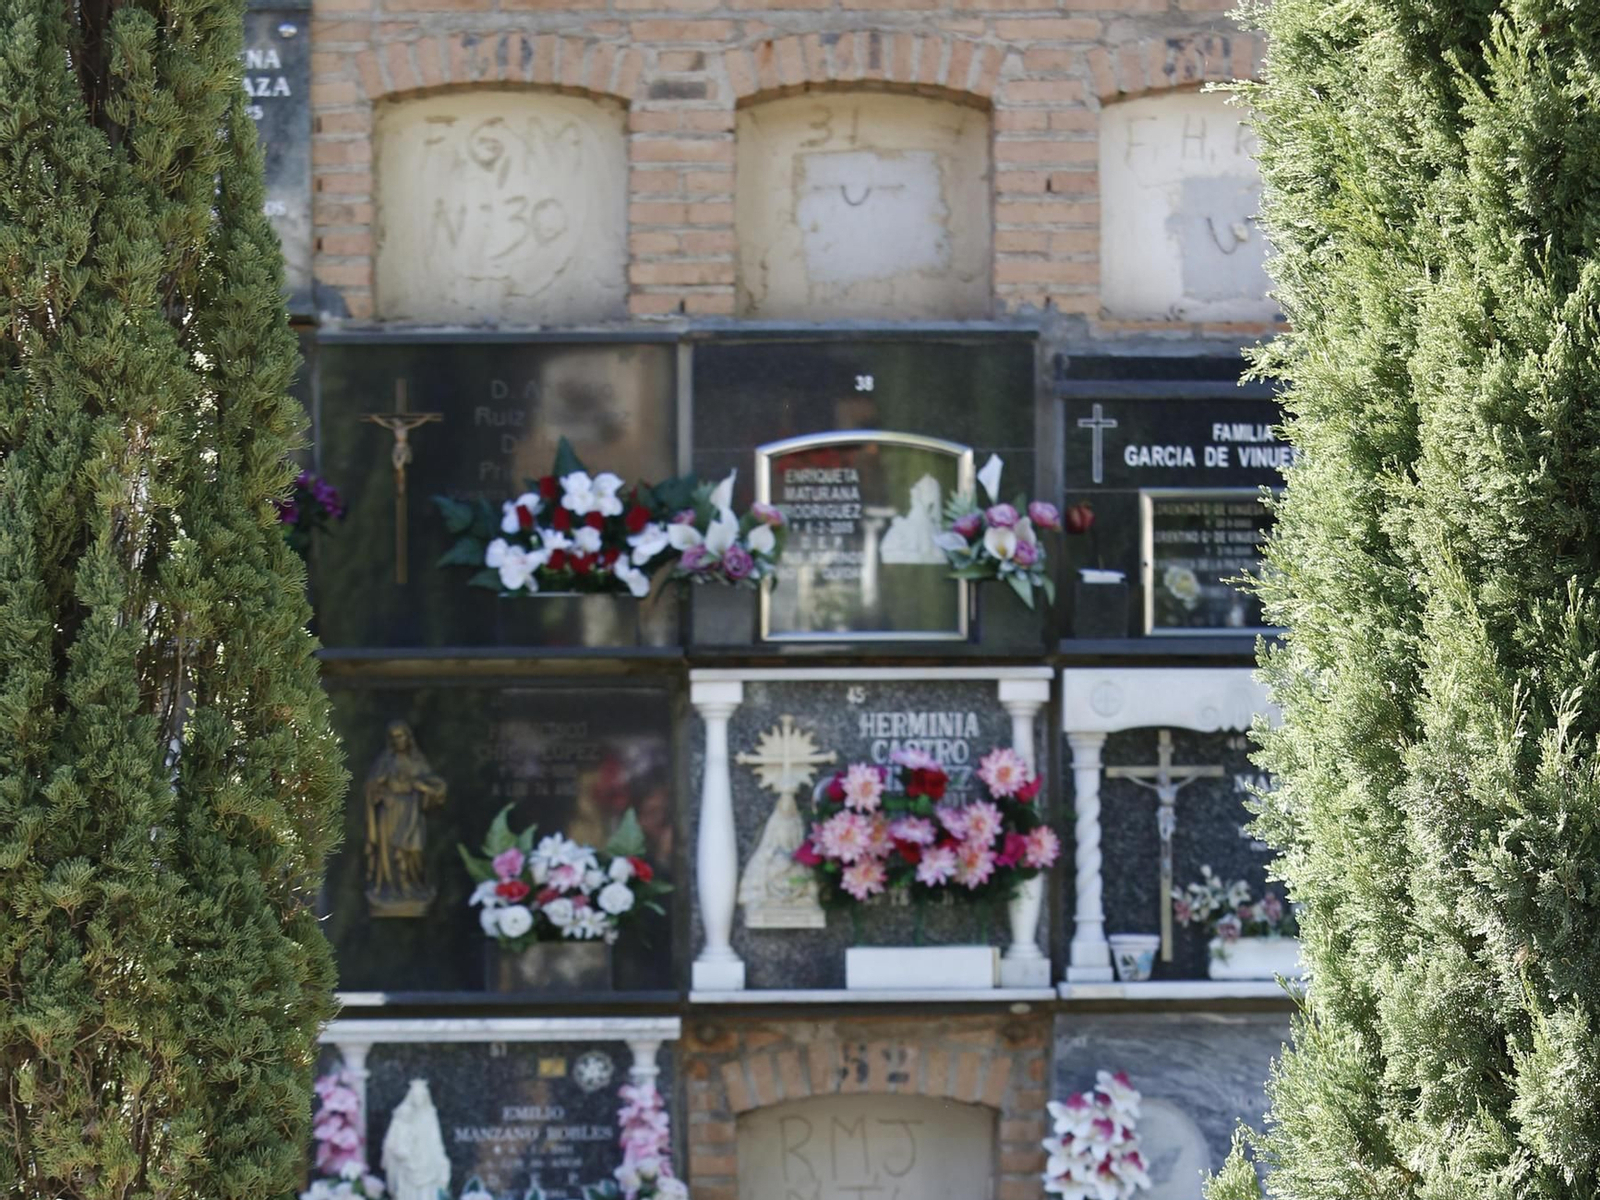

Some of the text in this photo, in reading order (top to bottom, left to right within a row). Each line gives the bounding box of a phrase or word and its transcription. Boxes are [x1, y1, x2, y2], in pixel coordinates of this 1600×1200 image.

[244, 49, 282, 69] NA
[242, 76, 292, 97] AZA
[855, 375, 874, 392] 38
[1212, 422, 1275, 442] FAMILIA
[1123, 444, 1196, 467] GARCIA
[1204, 445, 1229, 467] DE
[784, 467, 859, 483] ENRIQUETA
[784, 485, 860, 501] MATURANA
[859, 711, 980, 738] HERMINIA
[502, 1106, 565, 1121] EMILIO
[453, 1125, 614, 1143] MANZANO ROBLES
